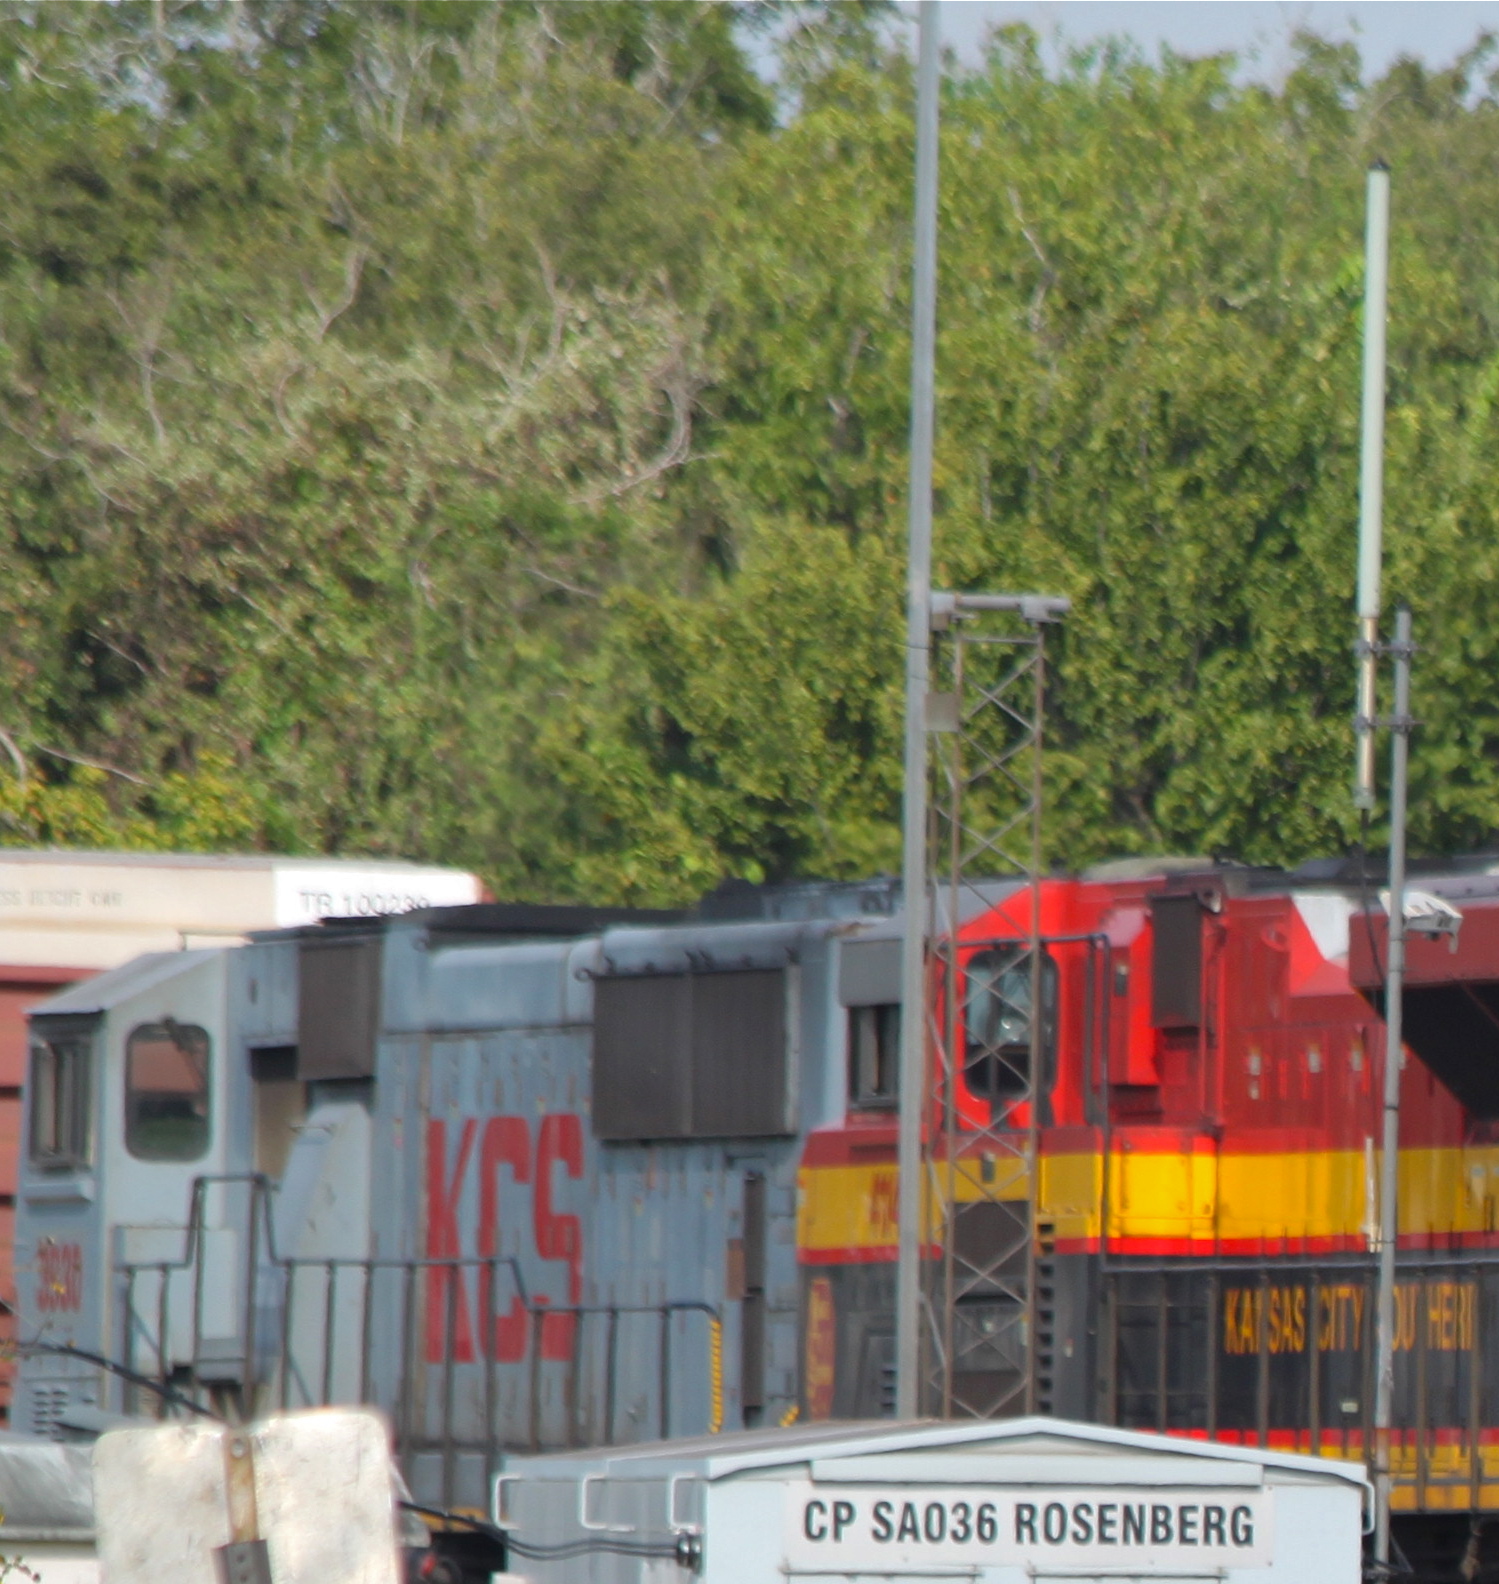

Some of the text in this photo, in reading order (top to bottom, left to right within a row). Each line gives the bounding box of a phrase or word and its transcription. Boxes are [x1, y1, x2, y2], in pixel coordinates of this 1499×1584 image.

[427, 1113, 584, 1365] KCS
[803, 1500, 1255, 1548] CP SA036 ROSENBERG
